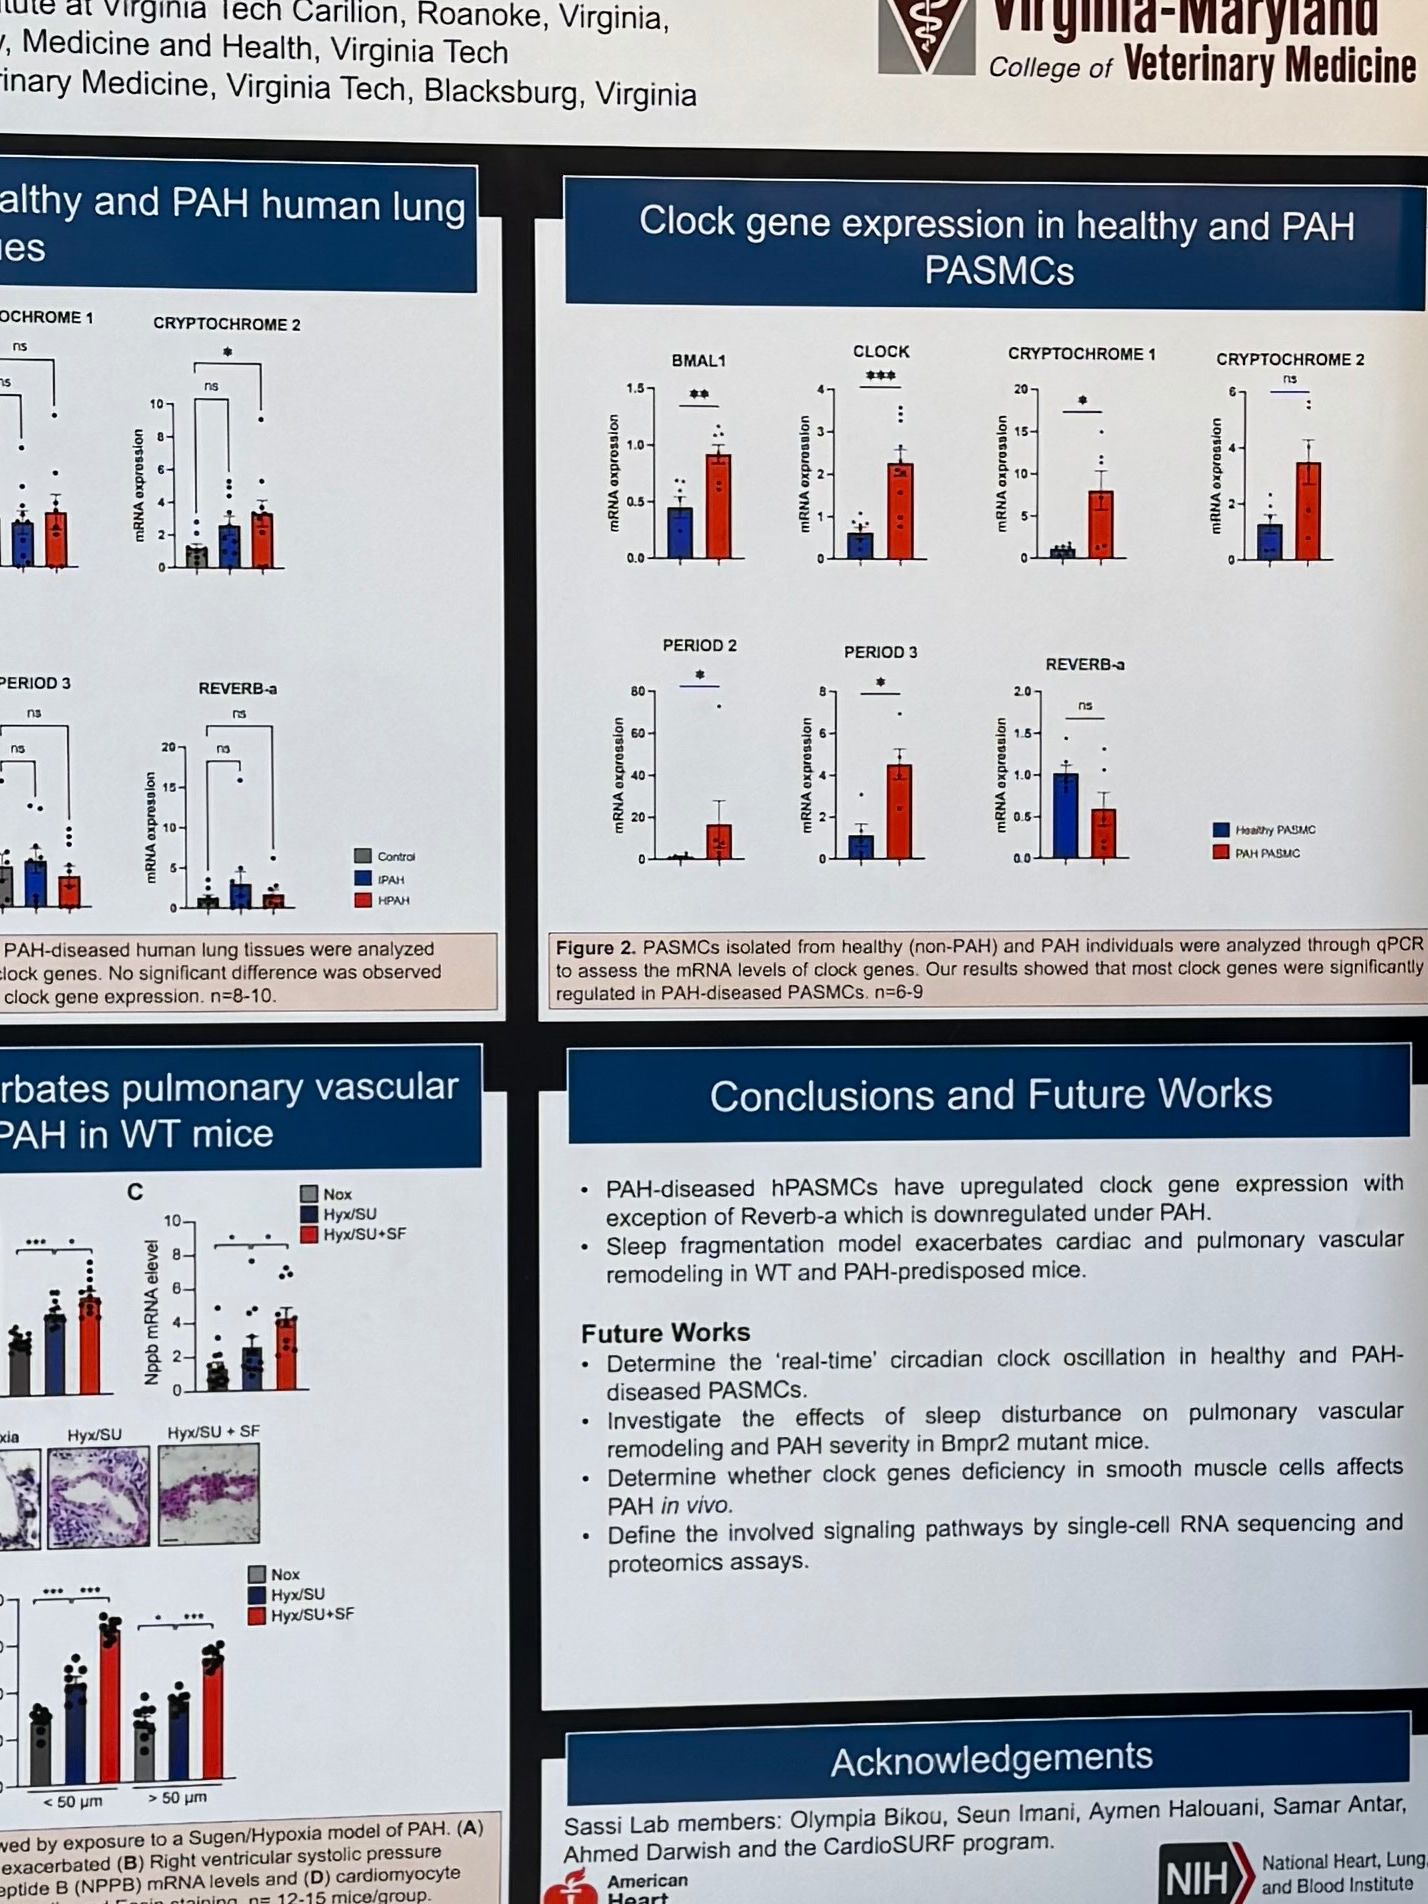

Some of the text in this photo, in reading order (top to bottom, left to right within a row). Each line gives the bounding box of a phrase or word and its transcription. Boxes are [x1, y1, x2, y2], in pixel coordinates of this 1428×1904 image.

[989, 42, 1417, 89] College of Veterinary Medicine
[94, 185, 159, 217] and
[173, 186, 248, 218] PAH
[262, 188, 380, 221] human
[394, 190, 465, 230] lung
[86, 311, 93, 324] 1
[1216, 352, 1365, 366] CRYPTOCHROME 2
[663, 638, 737, 652] PERIOD 2
[377, 851, 416, 862] Control
[1235, 848, 1259, 859] PAH
[123, 1072, 304, 1110] pulmonary
[315, 1070, 460, 1101] vascular
[711, 1076, 1273, 1113] Conclusions and Future Works
[80, 1119, 108, 1149] in
[120, 1118, 182, 1149] WT
[193, 1118, 274, 1148] mice
[324, 1188, 353, 1201] Nox
[323, 1207, 377, 1224] Hyx/SU
[606, 1202, 1211, 1231] exception of Reverb-a which is downregulated under PAH.
[324, 1226, 407, 1244] Hyx/SU+SF
[582, 1321, 751, 1344] Future Works
[830, 1741, 1154, 1780] Acknowledgements
[57, 1795, 76, 1809] 50
[563, 1834, 1055, 1864] Ahmed Darwish and the CardioSURF program.
[1262, 1853, 1328, 1871] National
[1333, 1853, 1382, 1870] Heart,
[607, 1873, 689, 1889] American
[1166, 1861, 1228, 1896] NIH
[1262, 1876, 1414, 1895] and Blood Institute
